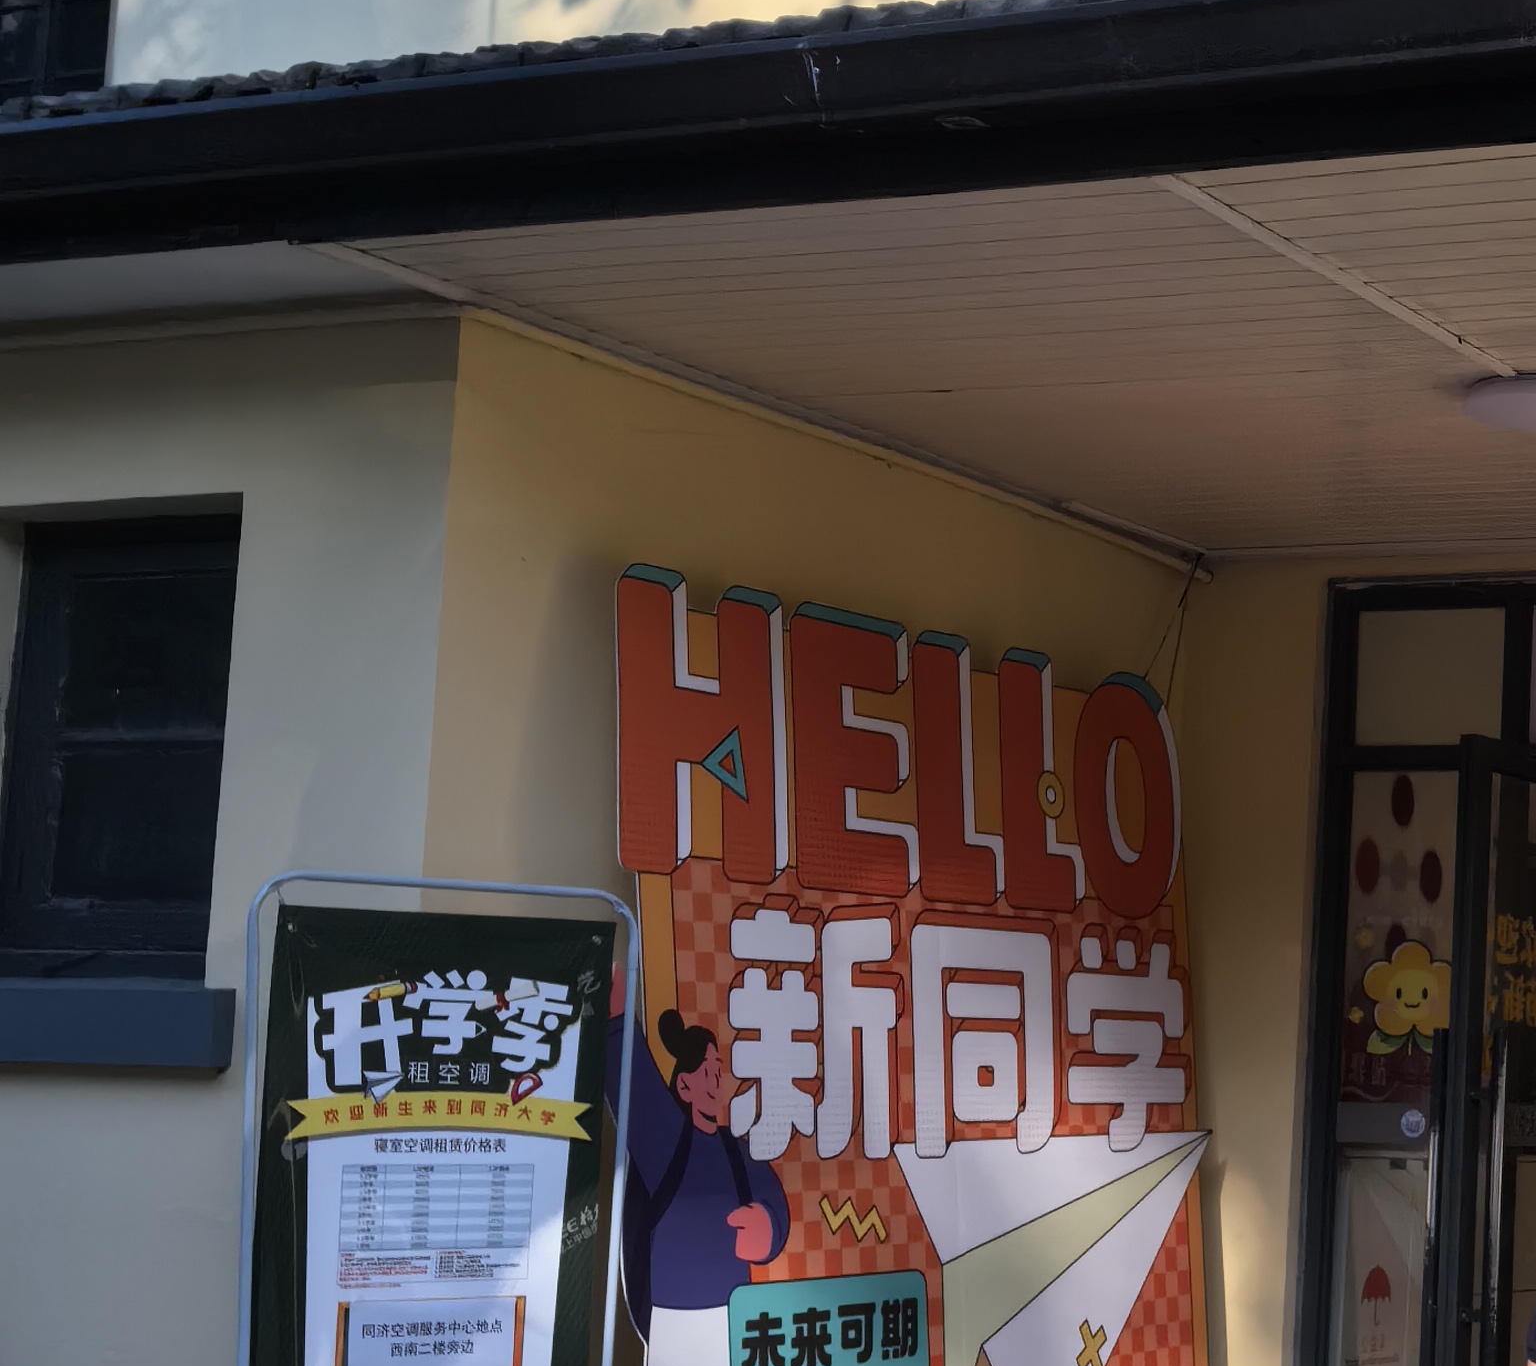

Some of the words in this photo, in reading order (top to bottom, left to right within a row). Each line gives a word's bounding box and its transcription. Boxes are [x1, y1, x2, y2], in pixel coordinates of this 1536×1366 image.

[617, 563, 1182, 919] HELLO
[321, 969, 573, 1087] 开学季
[728, 897, 1190, 1161] 新同学
[408, 1061, 490, 1085] 租空调
[323, 1098, 557, 1126] 欢迎新生来到同济大学
[374, 1137, 507, 1154] 寝室空调租赁价格表
[362, 1318, 503, 1339] 同济空调服务中心地点
[390, 1339, 474, 1358] 西南二楼旁边
